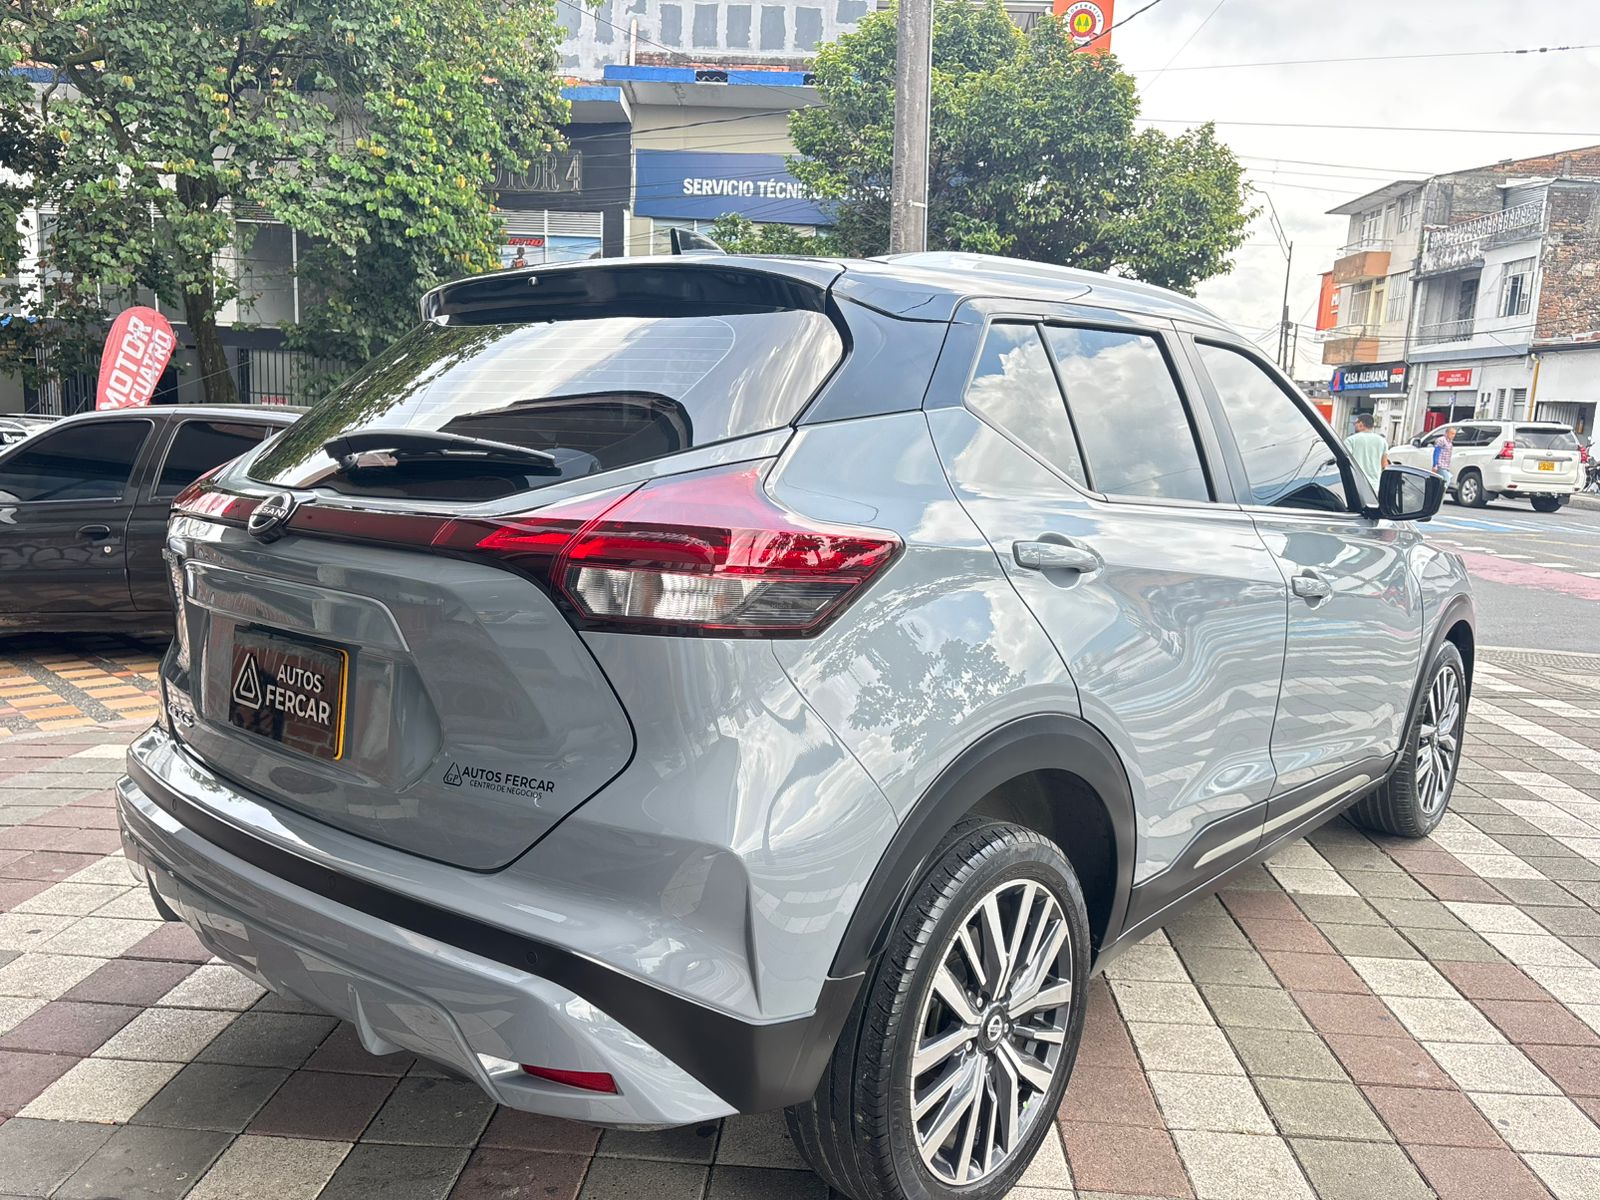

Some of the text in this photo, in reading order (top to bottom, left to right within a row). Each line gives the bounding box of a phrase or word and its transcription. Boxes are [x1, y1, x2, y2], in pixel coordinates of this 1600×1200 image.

[565, 153, 581, 192] 4
[683, 178, 754, 197] SERVICIO
[757, 178, 822, 199] TÉCNI
[100, 315, 153, 410] MOTOR
[129, 329, 172, 407] CUATRO
[1344, 372, 1358, 384] CASA
[1358, 370, 1388, 383] ALEMANA
[256, 505, 286, 519] SAN
[277, 664, 322, 694] AUTOS
[265, 684, 331, 725] FERCAR
[462, 766, 555, 793] AUTOS FERCAR
[469, 779, 495, 791] CENTRO
[506, 786, 543, 799] NEGOCIOS
